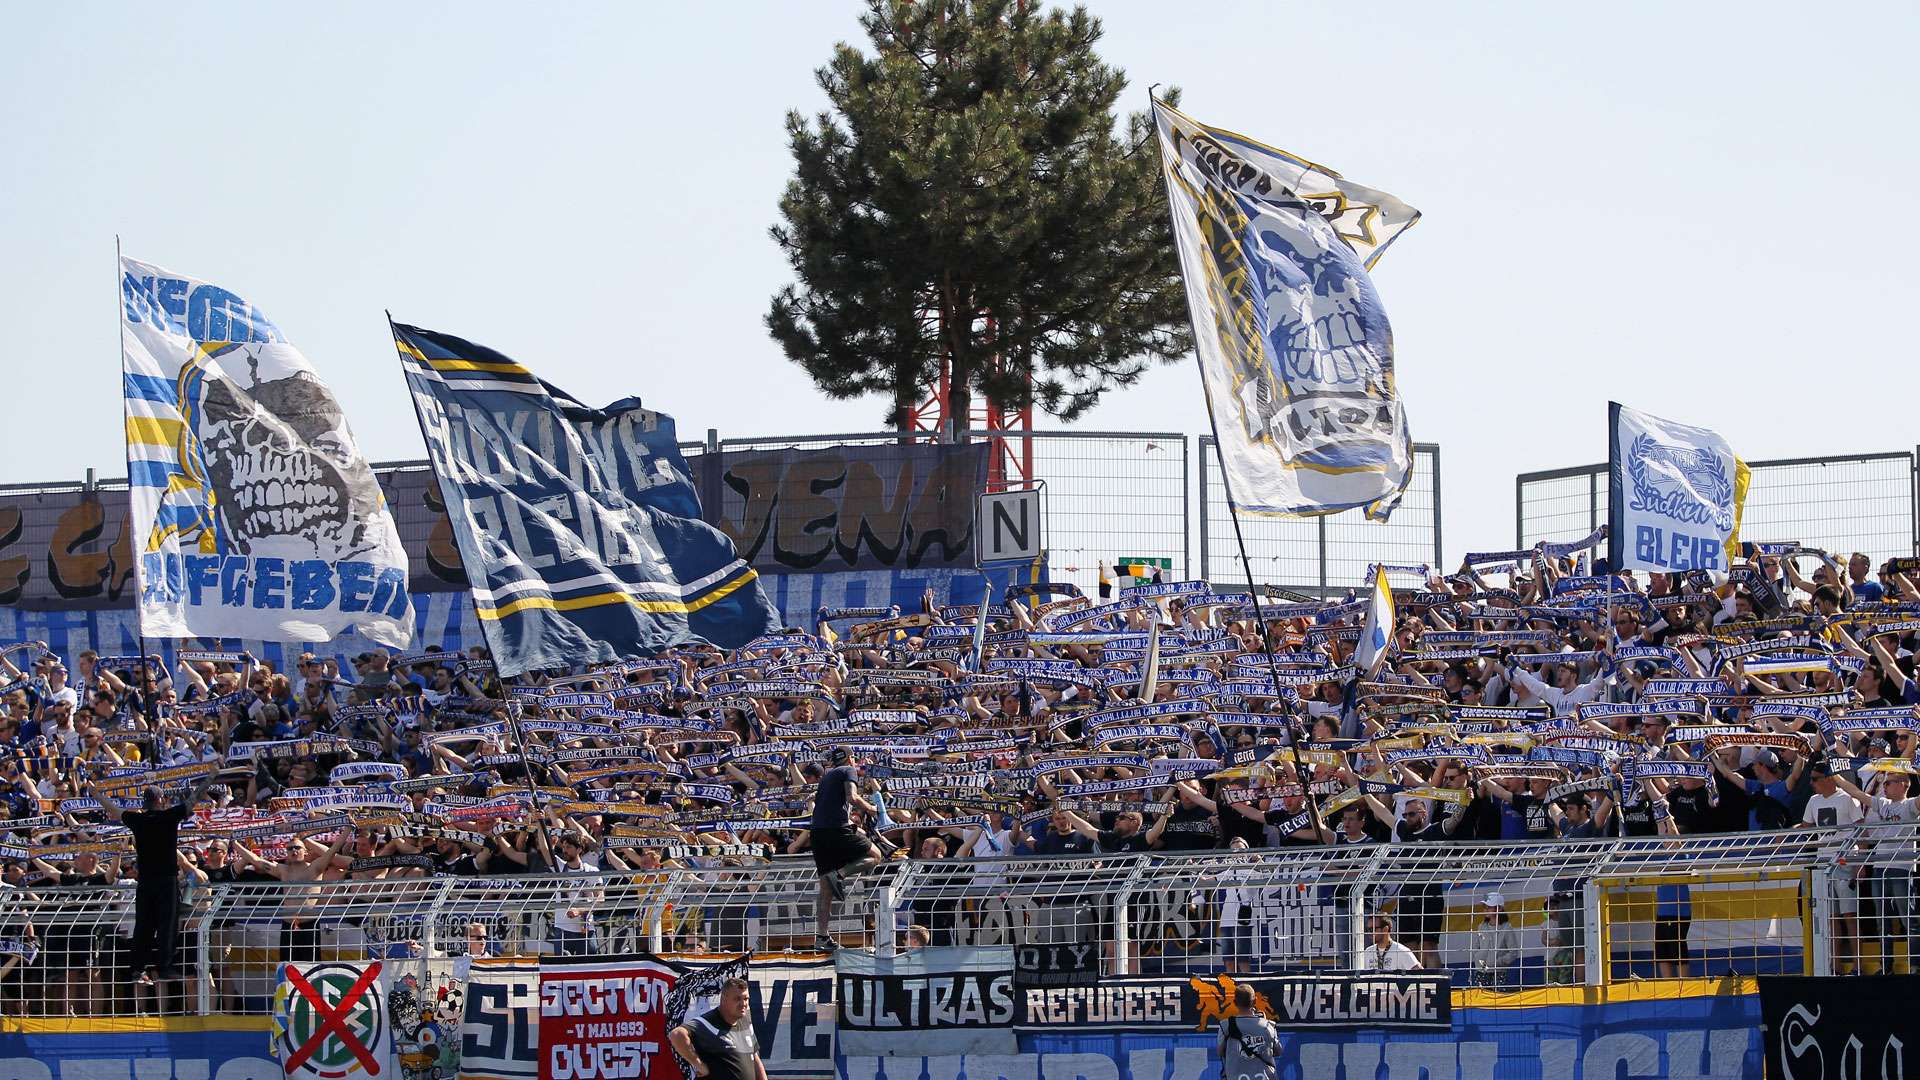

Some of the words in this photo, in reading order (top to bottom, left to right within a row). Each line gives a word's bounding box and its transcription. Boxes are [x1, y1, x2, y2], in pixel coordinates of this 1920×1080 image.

[720, 455, 976, 568] JENA
[993, 498, 1029, 553] N
[849, 711, 917, 725] UNBEUGSAM
[730, 741, 804, 758] UNBEUGSAM
[701, 786, 732, 800] ZEISS
[541, 976, 669, 1017] SECTION
[844, 975, 1015, 1028] ULTRAS
[1026, 986, 1183, 1023] REFUGEES
[1282, 981, 1438, 1021] WELCOME
[589, 1021, 614, 1039] MAI
[616, 1020, 645, 1038] 1993
[551, 1040, 661, 1080] OUEST
